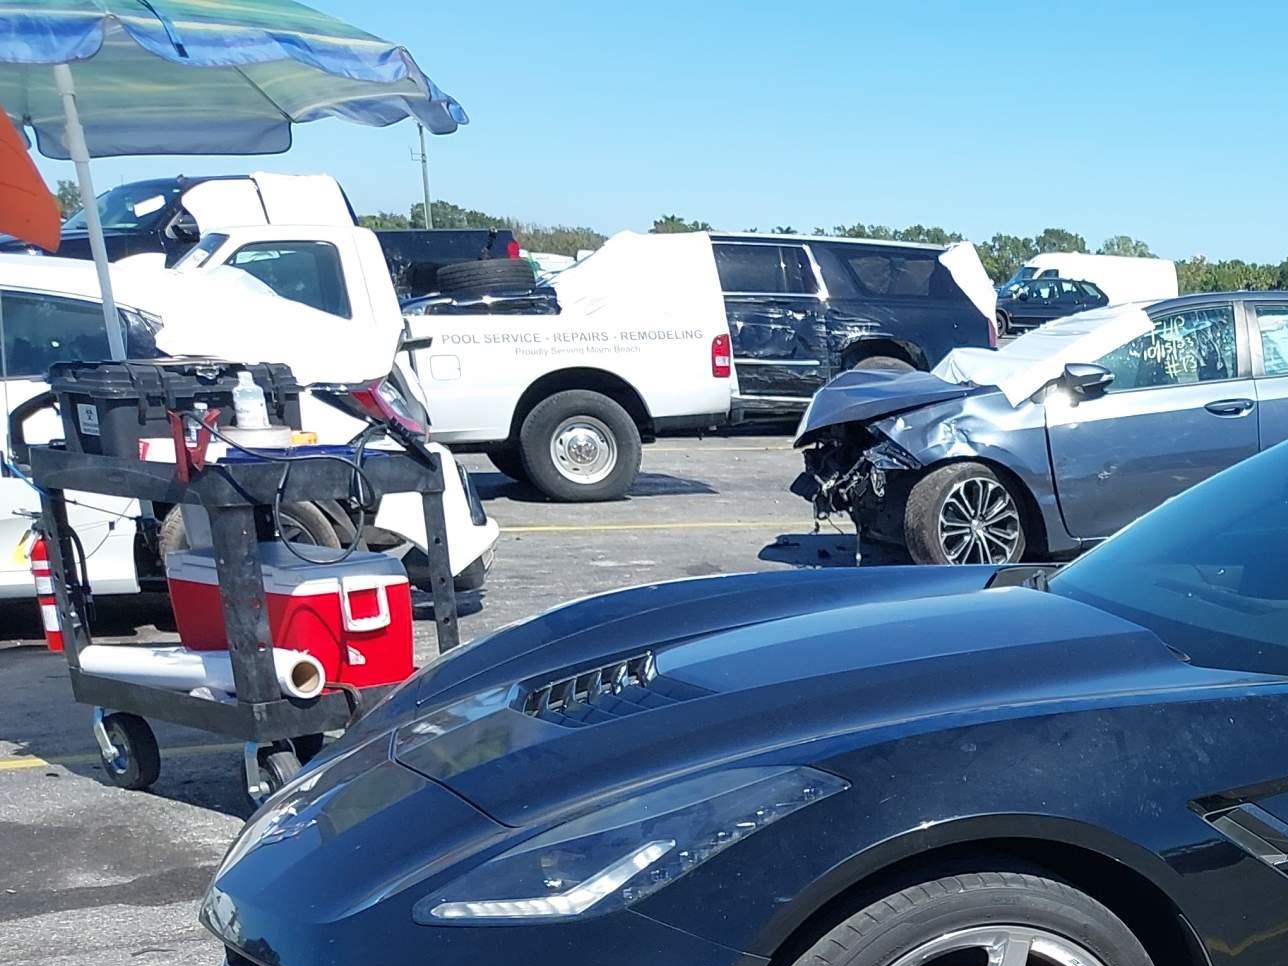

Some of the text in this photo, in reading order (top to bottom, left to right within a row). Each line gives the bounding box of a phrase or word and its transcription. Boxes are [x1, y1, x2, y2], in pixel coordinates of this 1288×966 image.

[441, 334, 481, 345] POOL
[484, 333, 541, 344] SERVICE
[553, 331, 609, 343] REPAIRS
[620, 329, 704, 341] REMODELING
